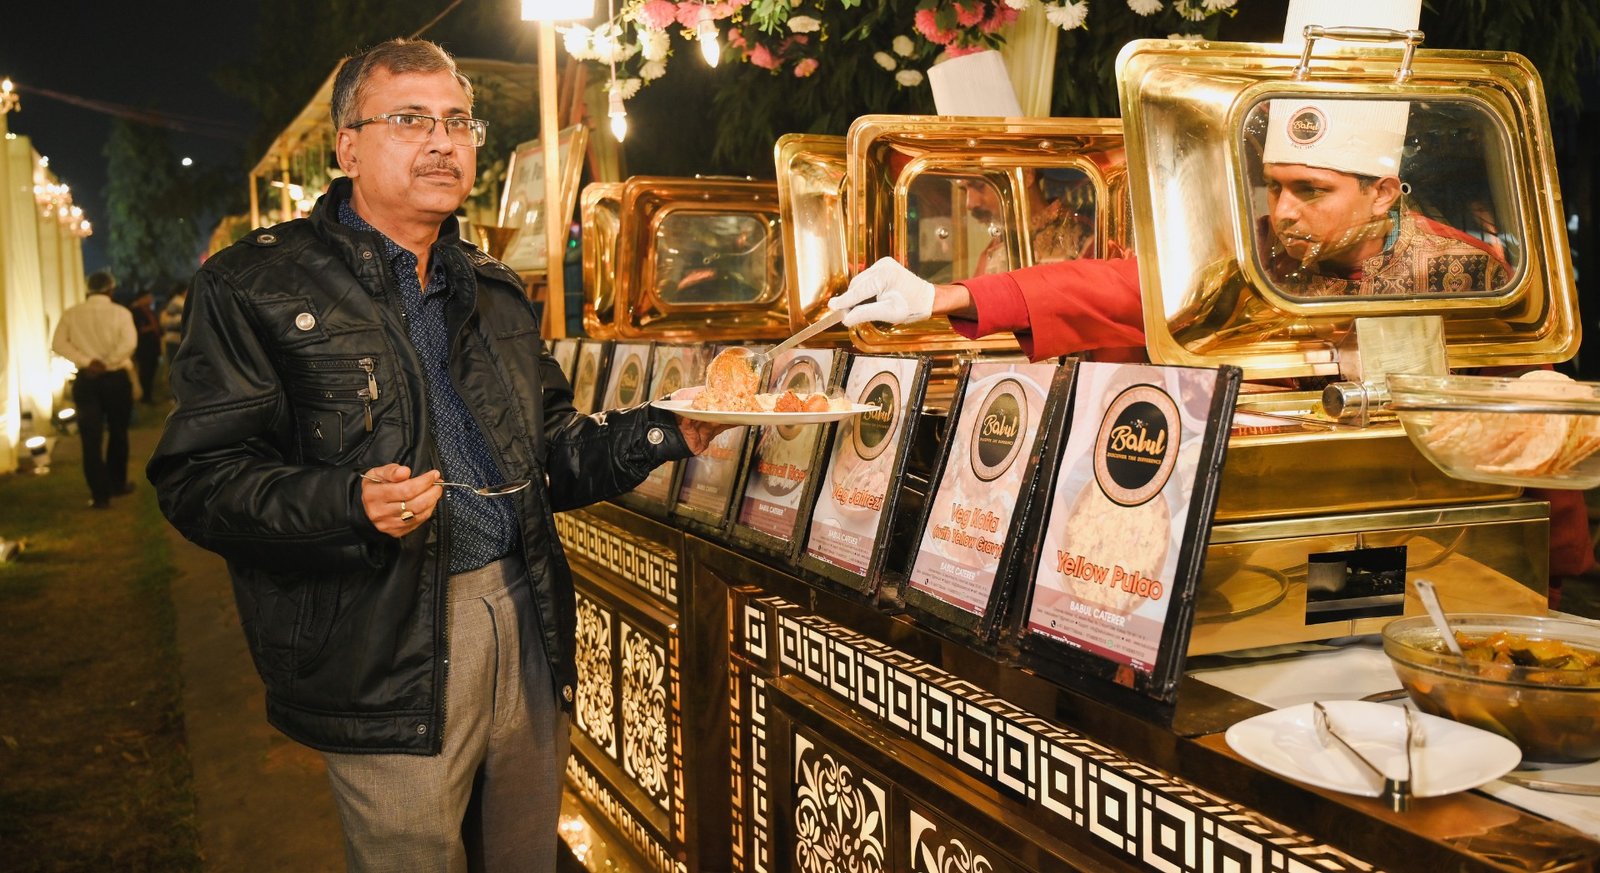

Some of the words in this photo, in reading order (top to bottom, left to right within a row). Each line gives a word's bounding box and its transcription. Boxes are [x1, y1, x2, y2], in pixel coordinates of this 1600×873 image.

[982, 414, 1018, 438] Babul
[1110, 425, 1165, 456] Babul
[832, 482, 850, 505] Veg
[849, 487, 885, 511] Jalfrezi
[951, 502, 971, 529] Veg
[970, 507, 1000, 533] Kofta
[932, 523, 951, 541] (with
[951, 528, 977, 549] Yellow
[1056, 549, 1109, 584] Yellow
[1110, 565, 1163, 600] Pulao
[1069, 600, 1092, 617] BABUL
[1093, 608, 1126, 627] CATERER
